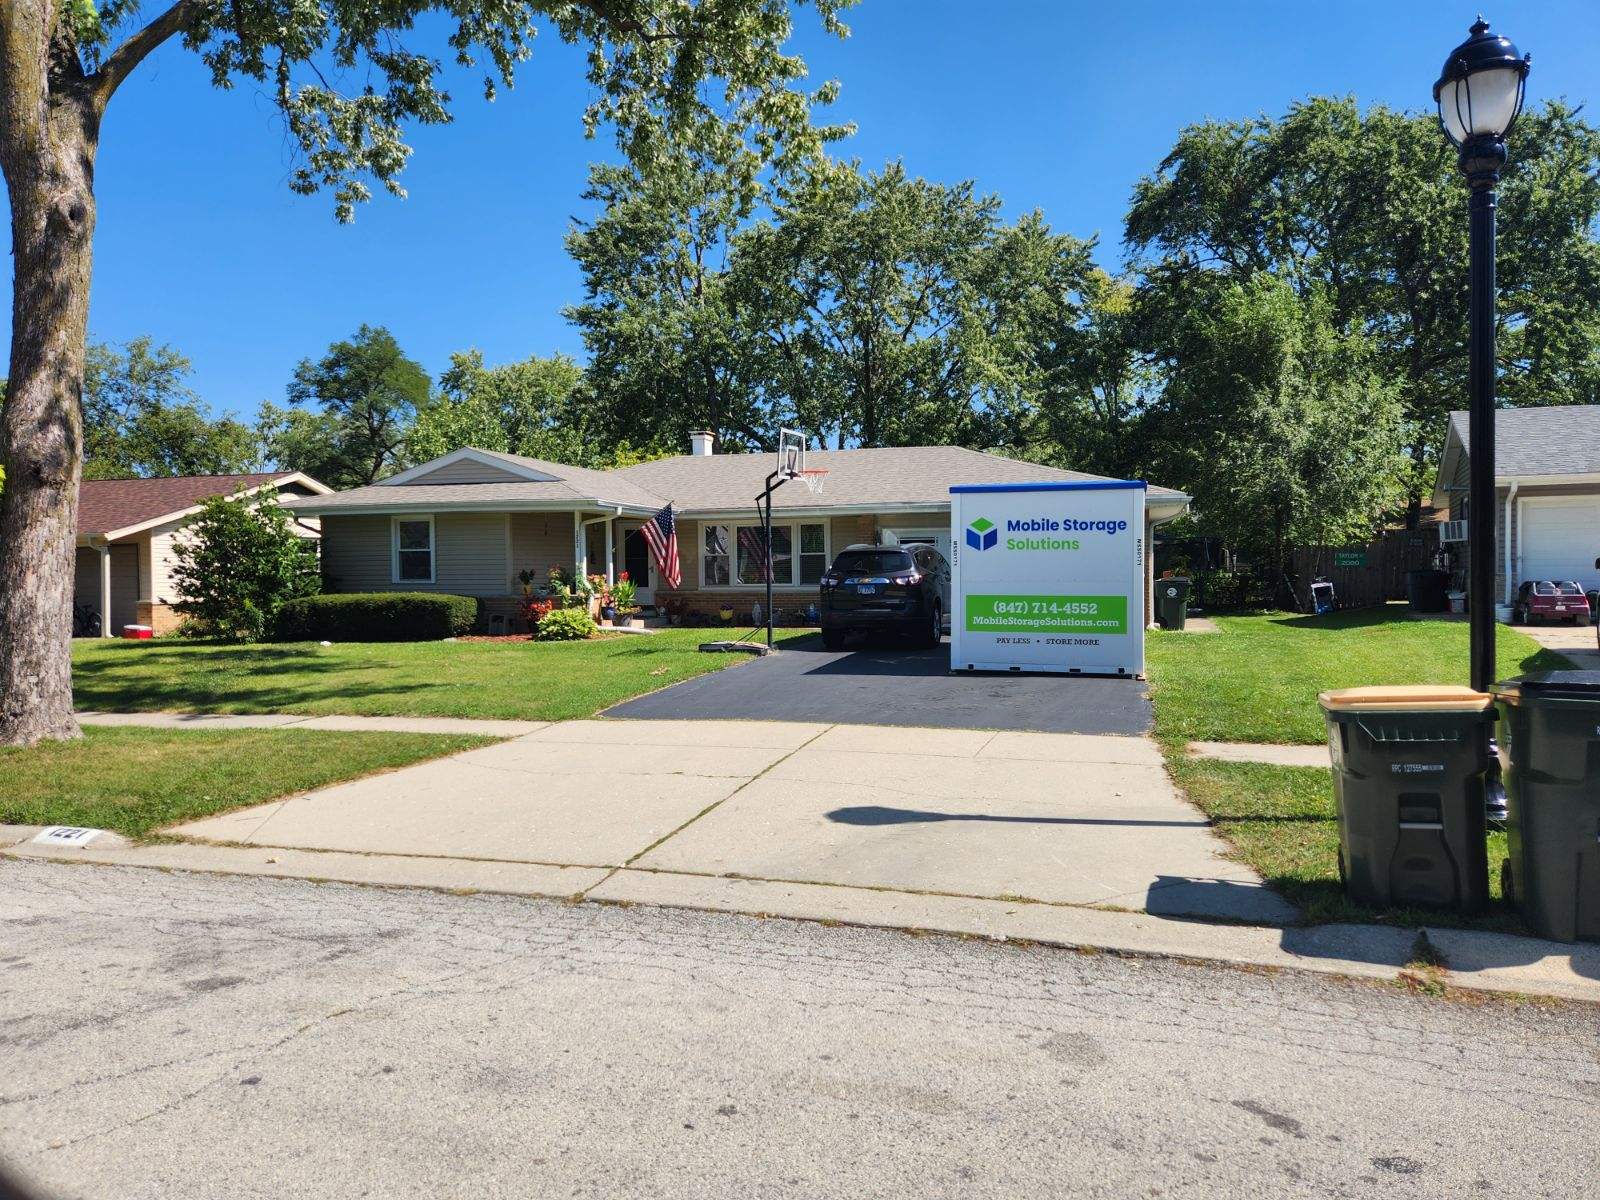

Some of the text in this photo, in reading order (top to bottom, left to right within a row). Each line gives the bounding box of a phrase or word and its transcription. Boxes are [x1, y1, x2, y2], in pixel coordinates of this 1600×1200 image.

[1007, 518, 1127, 535] Mobile Storage
[1007, 538, 1080, 551] Solutions
[993, 601, 1098, 615] (847) 714-4552
[973, 616, 1120, 628] MobileStorageSolutions.com
[996, 637, 1100, 646] PAY LESS STORE MORE
[48, 828, 90, 839] 1221
